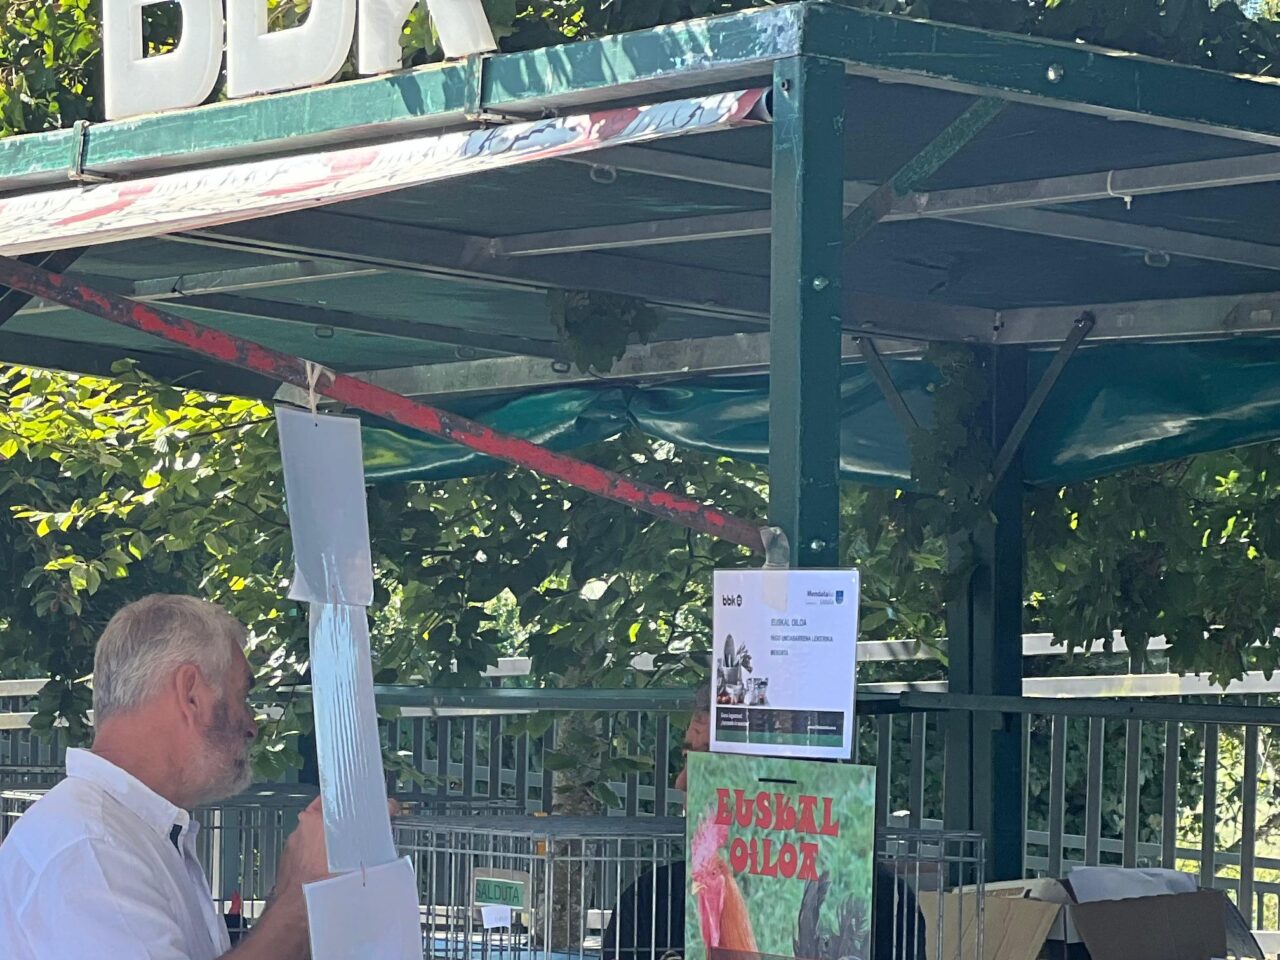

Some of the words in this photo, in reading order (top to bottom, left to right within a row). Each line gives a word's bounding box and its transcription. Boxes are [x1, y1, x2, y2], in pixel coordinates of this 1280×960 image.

[722, 595, 736, 607] bbk
[714, 788, 840, 837] EUSKAL
[730, 837, 819, 881] OILOA
[476, 883, 520, 903] SALDUTA
